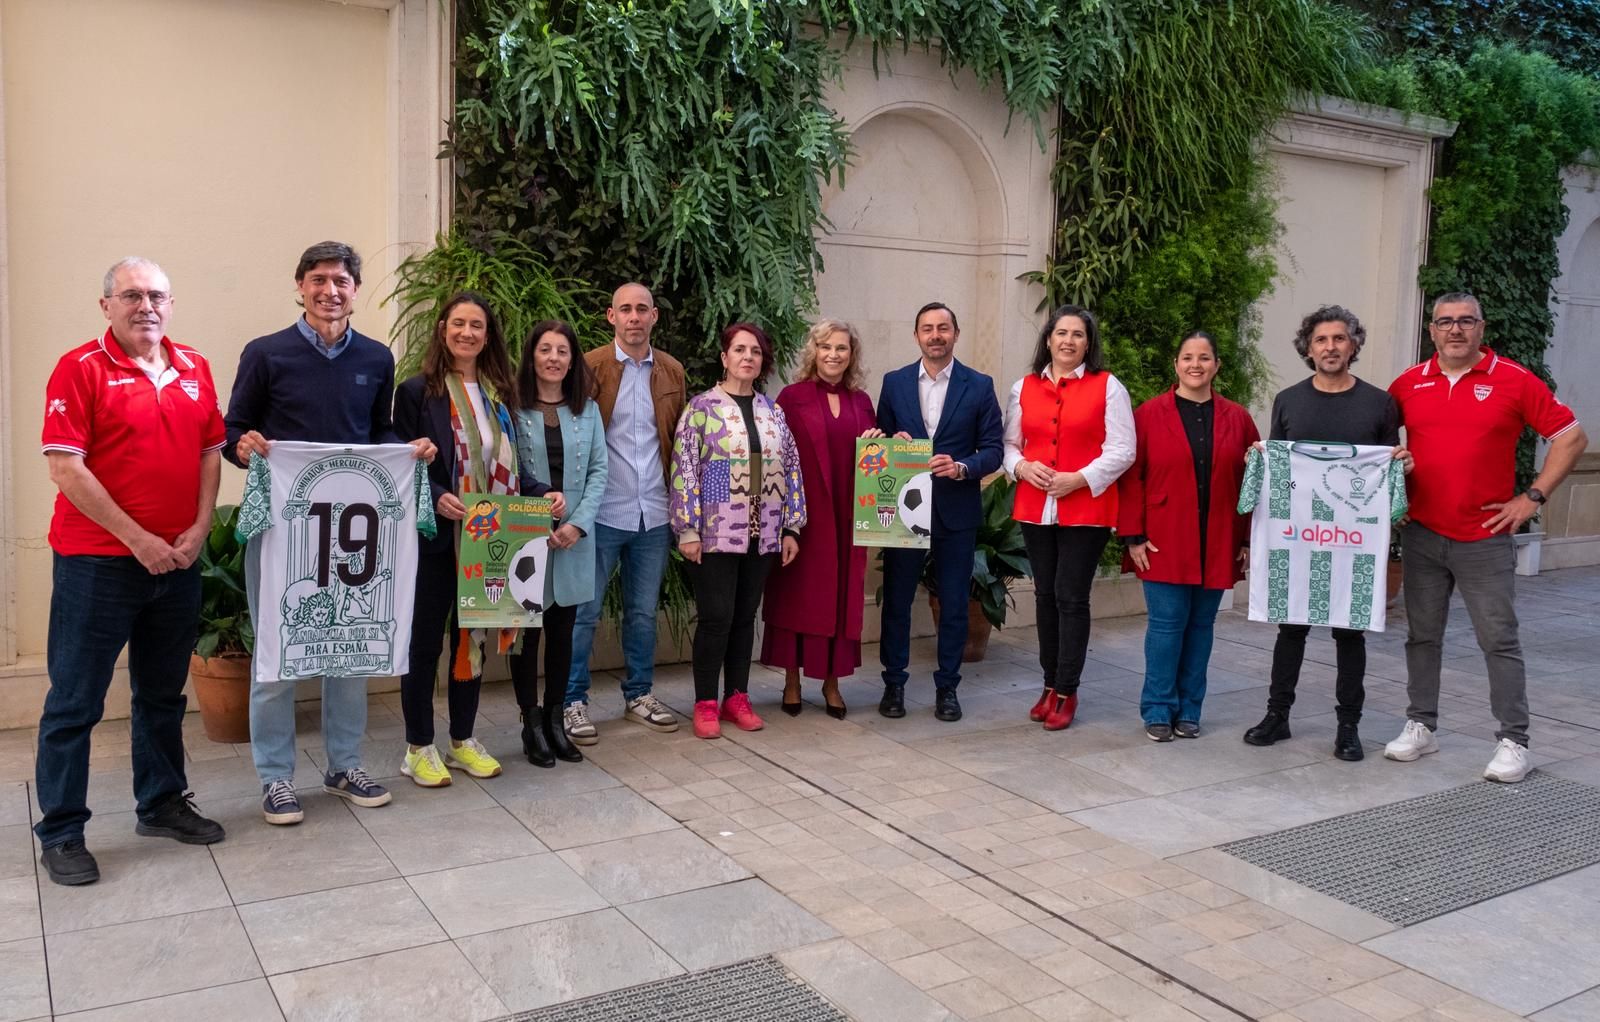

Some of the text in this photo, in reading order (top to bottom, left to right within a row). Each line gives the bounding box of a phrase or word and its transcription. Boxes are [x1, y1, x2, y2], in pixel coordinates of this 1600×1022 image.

[893, 444, 932, 453] SOLIDARIO
[295, 459, 395, 500] DOMINATOR HERCULES FUNDATOR
[857, 493, 877, 508] VS
[507, 503, 551, 514] SOLIDARIO
[855, 520, 870, 530] 5€
[1301, 524, 1363, 546] alpha
[308, 502, 380, 588] 19
[463, 562, 484, 581] VS
[460, 596, 476, 608] 5€
[305, 640, 369, 656] PARA ESPAÑA
[302, 658, 315, 670] LA
